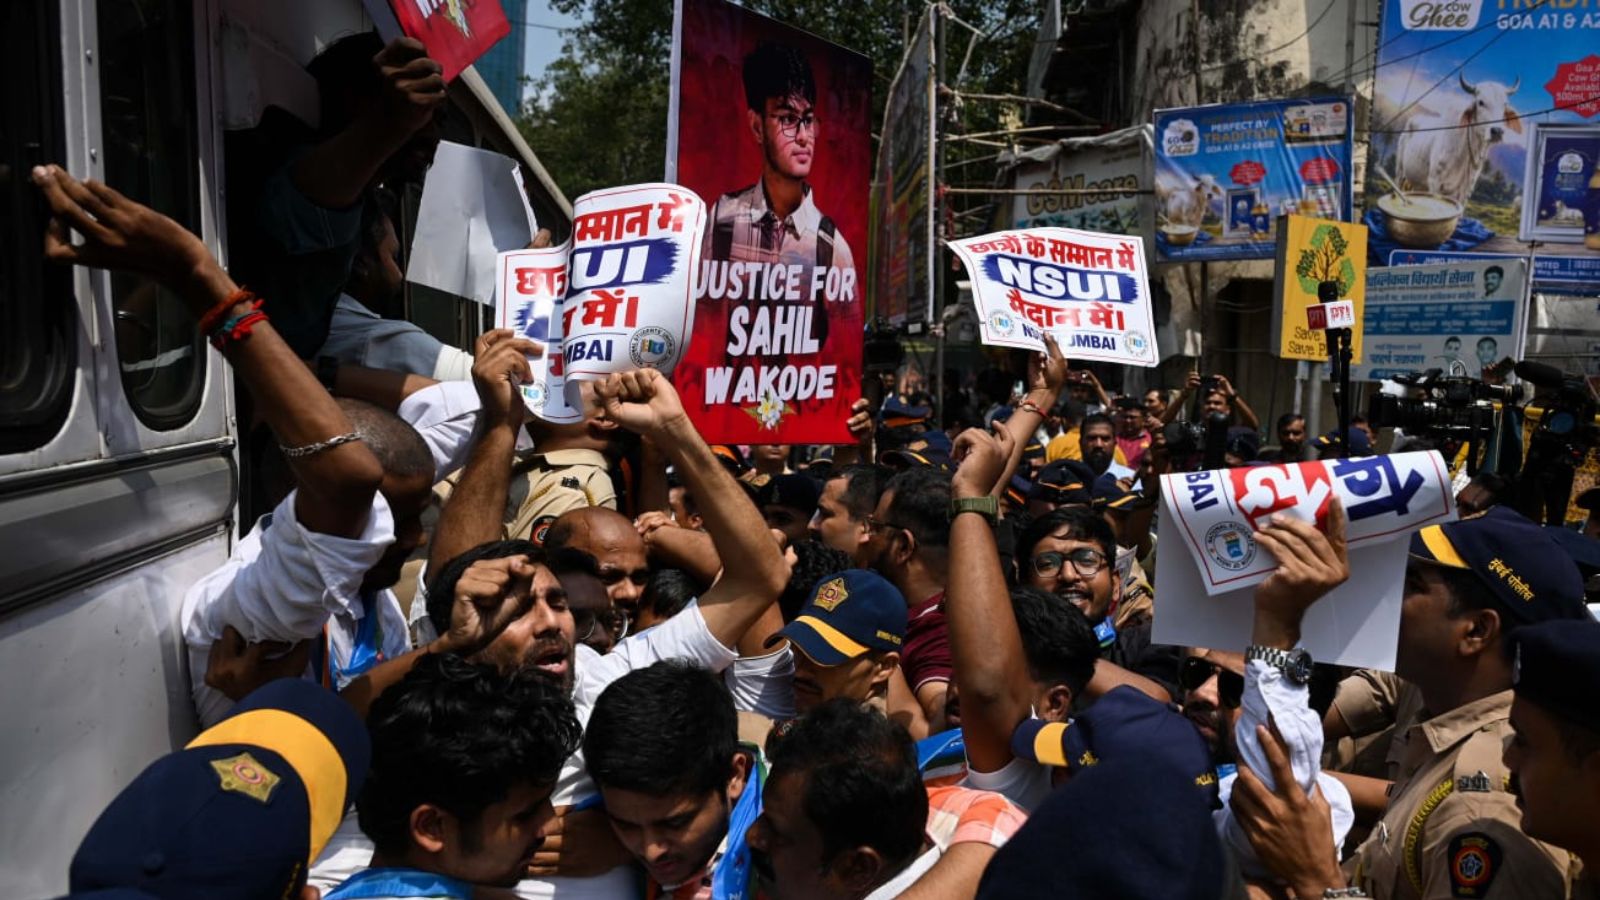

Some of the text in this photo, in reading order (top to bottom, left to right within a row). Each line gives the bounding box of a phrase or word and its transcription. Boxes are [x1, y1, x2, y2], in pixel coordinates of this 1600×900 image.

[1410, 2, 1468, 28] Ghee
[1497, 13, 1534, 30] GOA
[1538, 13, 1559, 29] A1
[1563, 12, 1576, 29] &
[967, 233, 1135, 271] छात्रों के सम्मान में
[696, 260, 856, 302] JUSTICE FOR
[997, 258, 1121, 301] NSUI
[1006, 288, 1080, 328] मैदान
[727, 305, 820, 356] SAHIL
[1288, 341, 1315, 355] Save
[1294, 326, 1320, 342] Save
[705, 365, 837, 404] WAKODE
